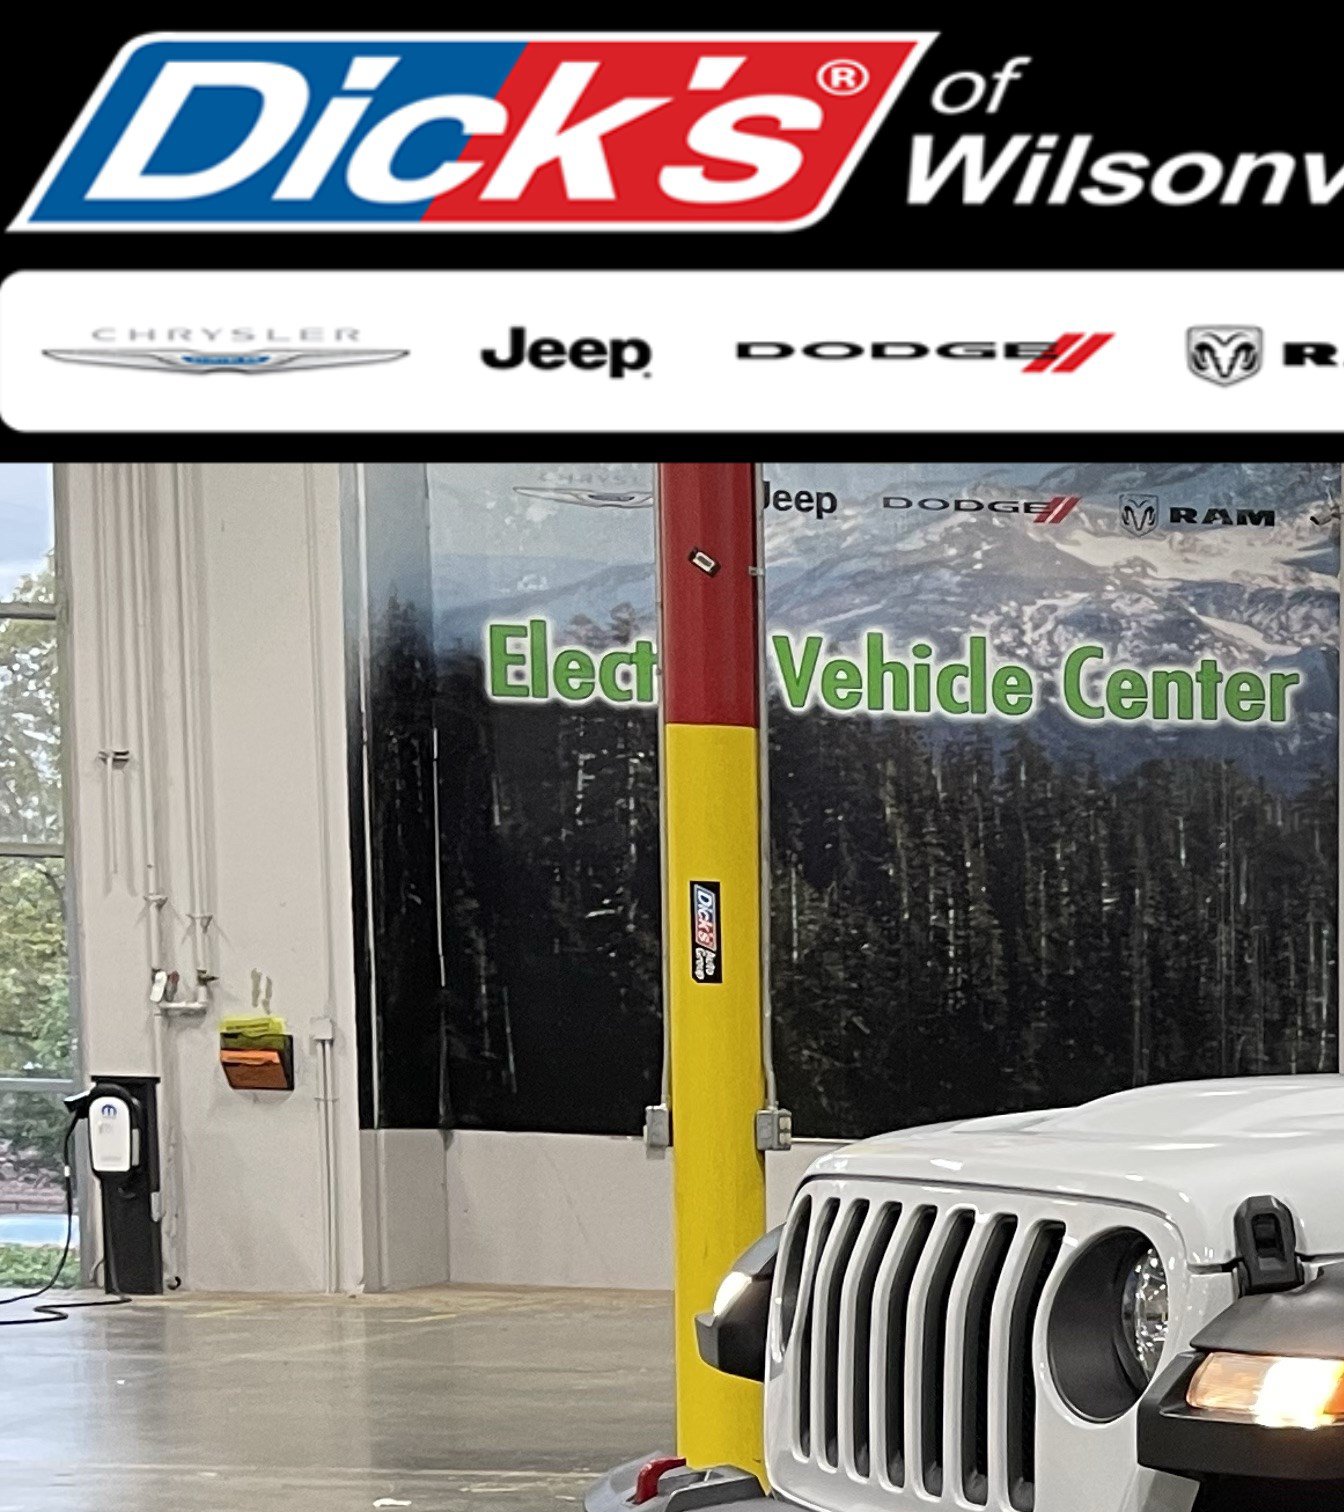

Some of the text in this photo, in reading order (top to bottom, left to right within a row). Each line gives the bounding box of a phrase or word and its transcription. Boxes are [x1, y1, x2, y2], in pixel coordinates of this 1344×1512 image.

[882, 495, 1052, 515] DODGE
[1170, 506, 1275, 527] RAM
[489, 618, 1301, 724] Elect Vehicle Center
